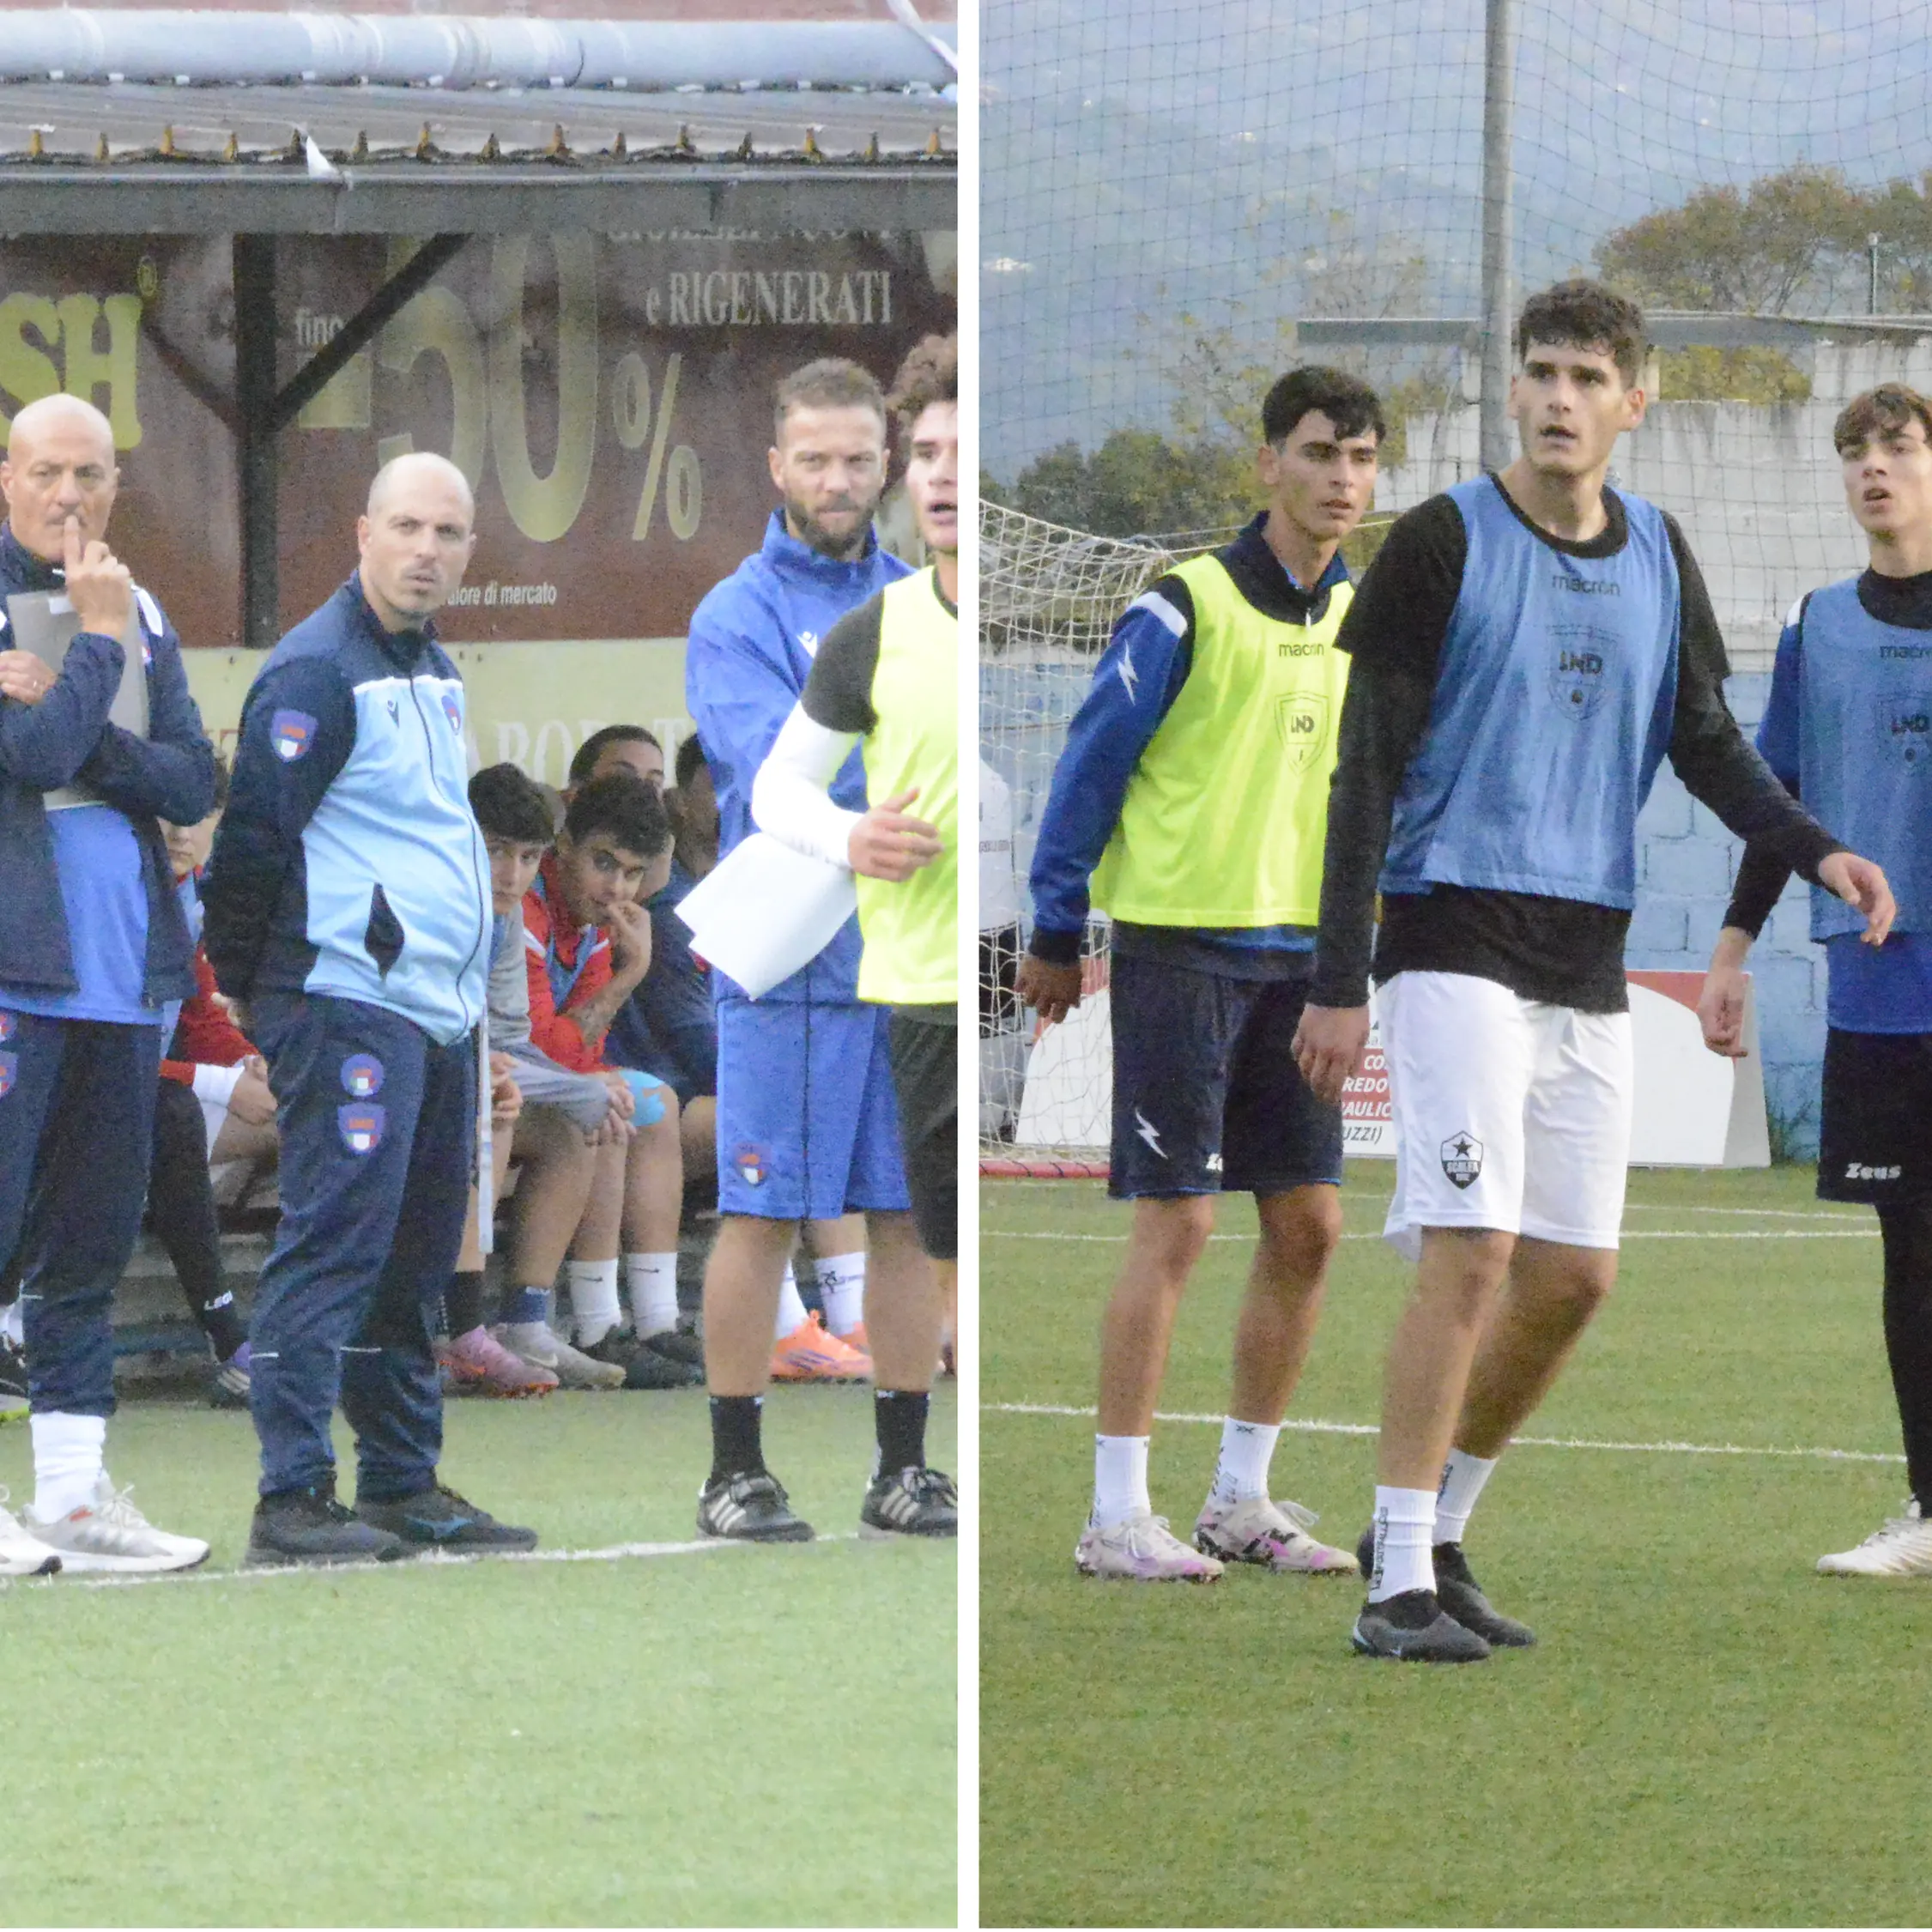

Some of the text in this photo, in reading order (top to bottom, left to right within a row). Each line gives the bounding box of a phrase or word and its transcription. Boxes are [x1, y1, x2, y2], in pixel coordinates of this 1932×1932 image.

[646, 270, 890, 325] e RIGENERATI
[447, 580, 557, 606] alore di mercato
[1552, 574, 1621, 597] macron
[1341, 1101, 1392, 1117] AULIC
[1844, 1162, 1902, 1180] Zeus
